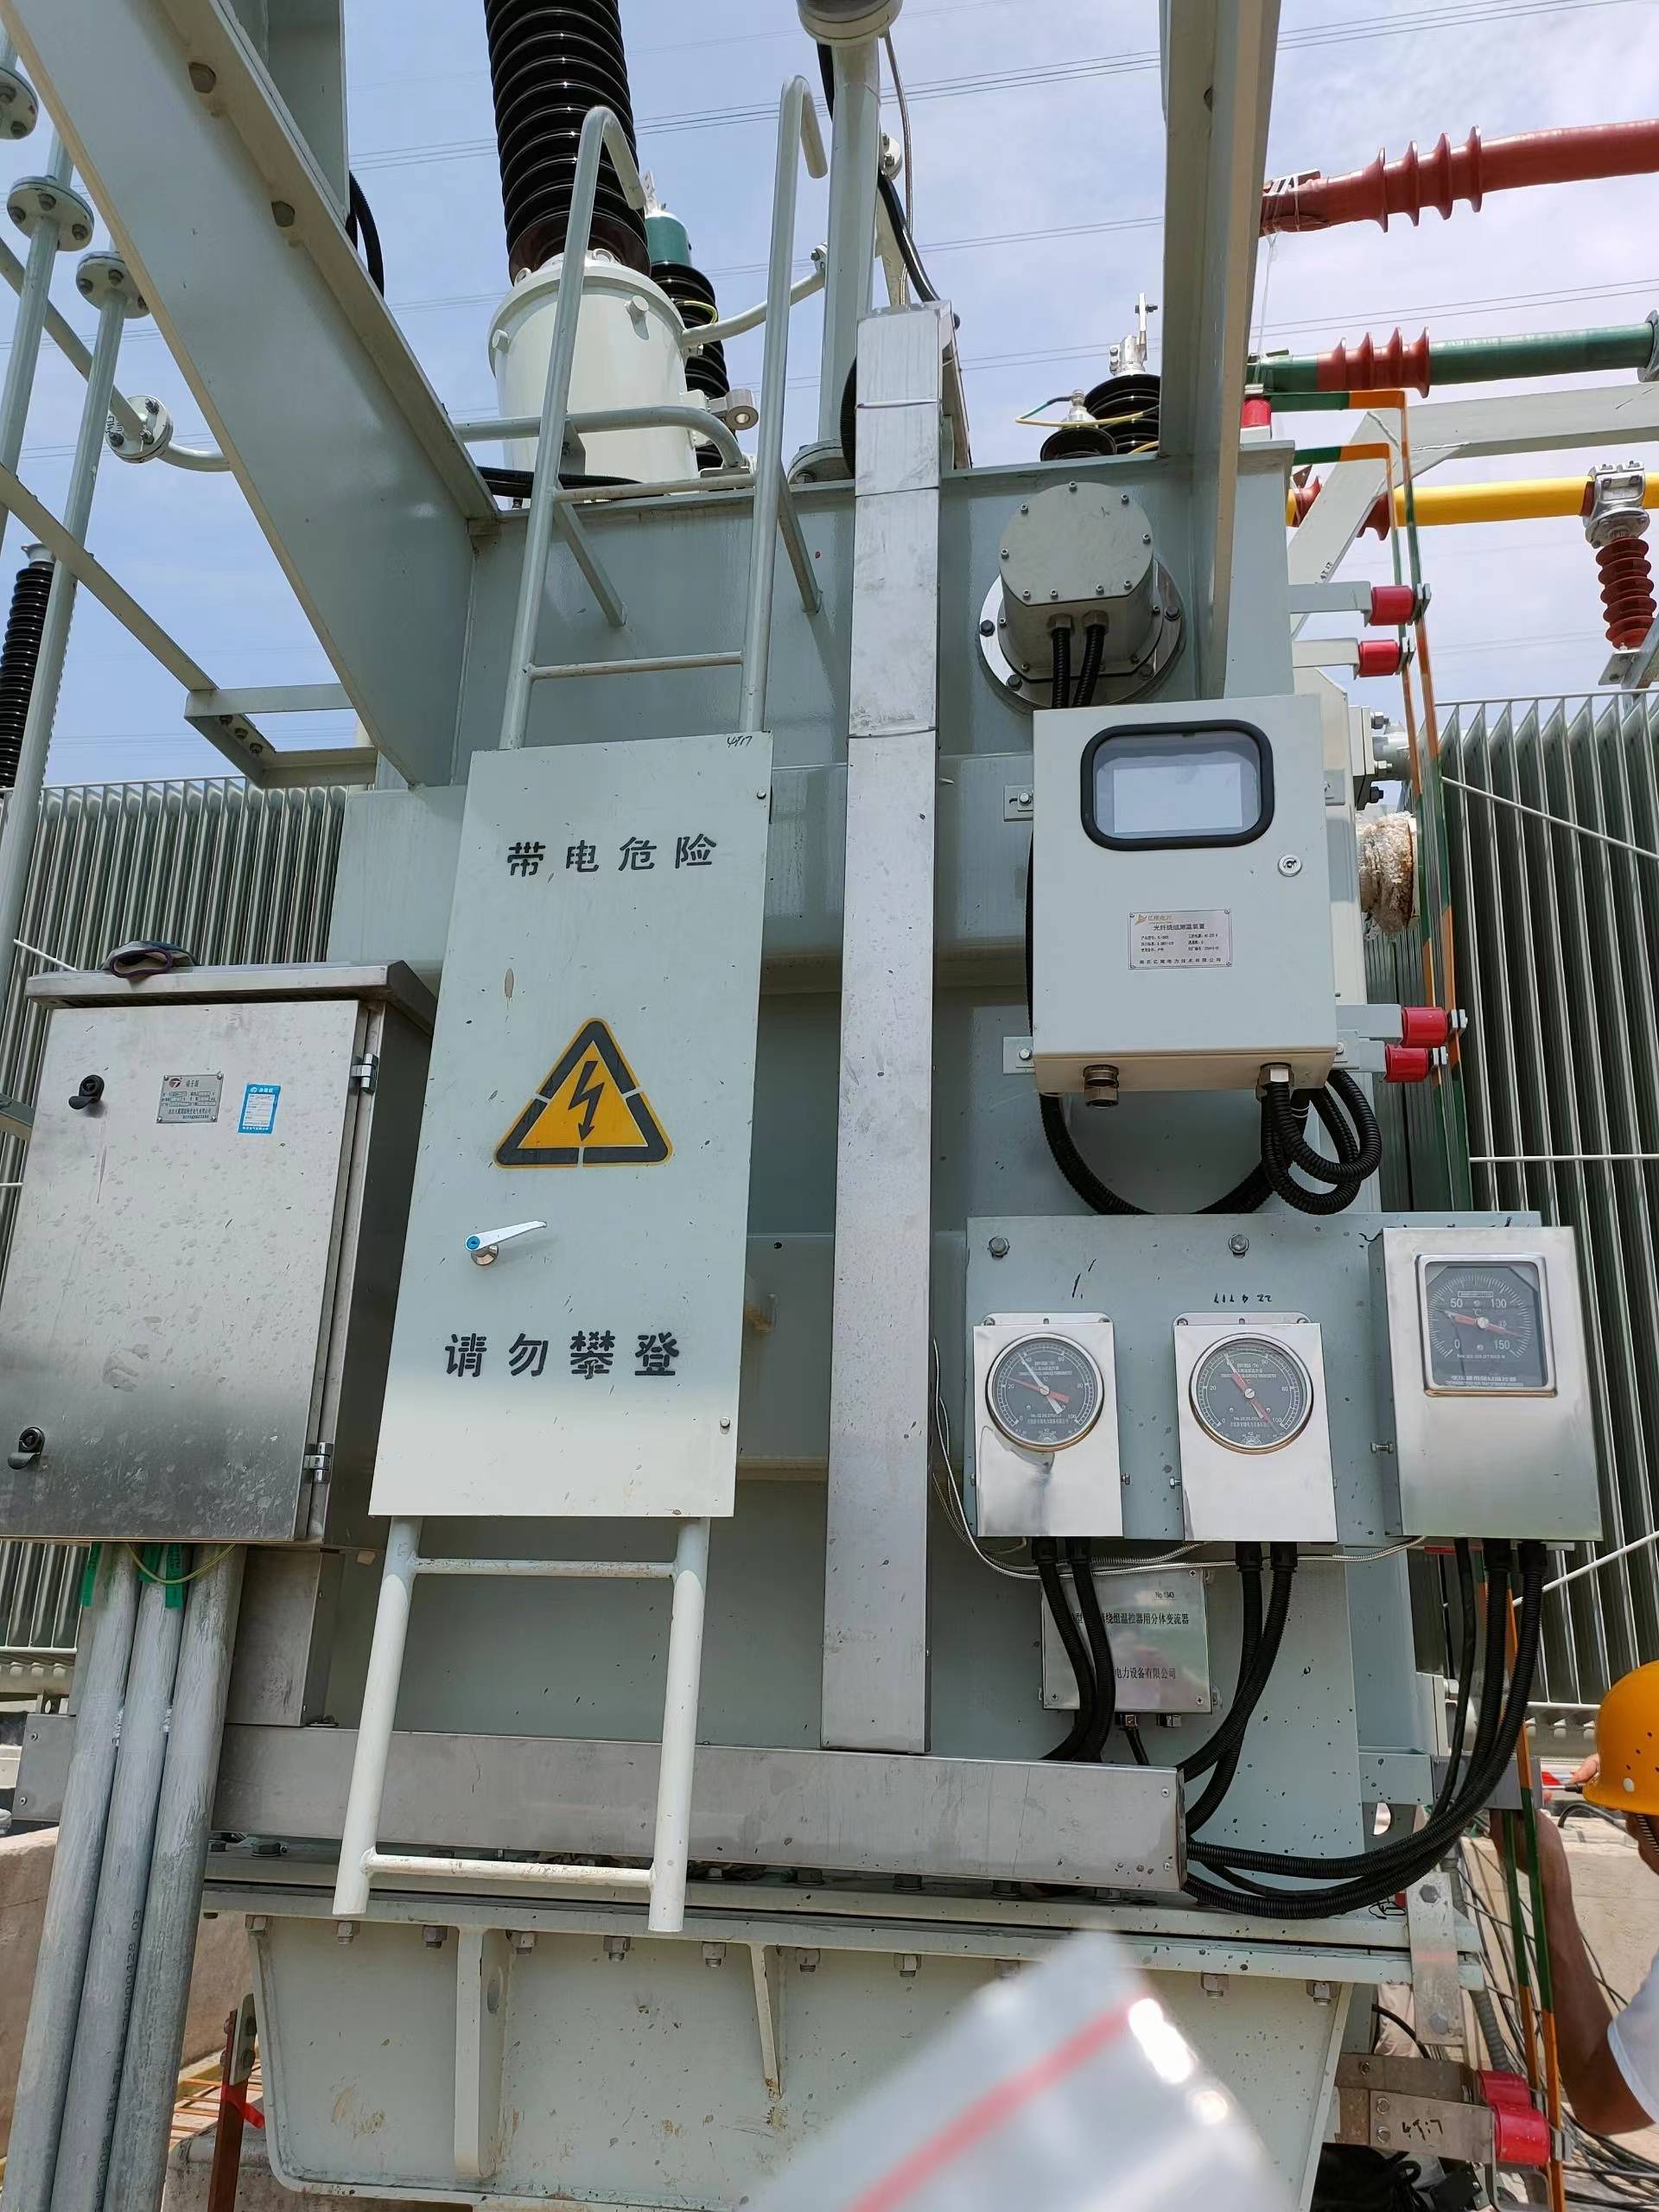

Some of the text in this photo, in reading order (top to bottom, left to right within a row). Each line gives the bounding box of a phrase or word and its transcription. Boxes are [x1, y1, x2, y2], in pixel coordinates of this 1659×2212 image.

[505, 833, 718, 877] 带电危险
[444, 1331, 681, 1380] 请勿攀登
[1494, 1340, 1510, 1350] 150
